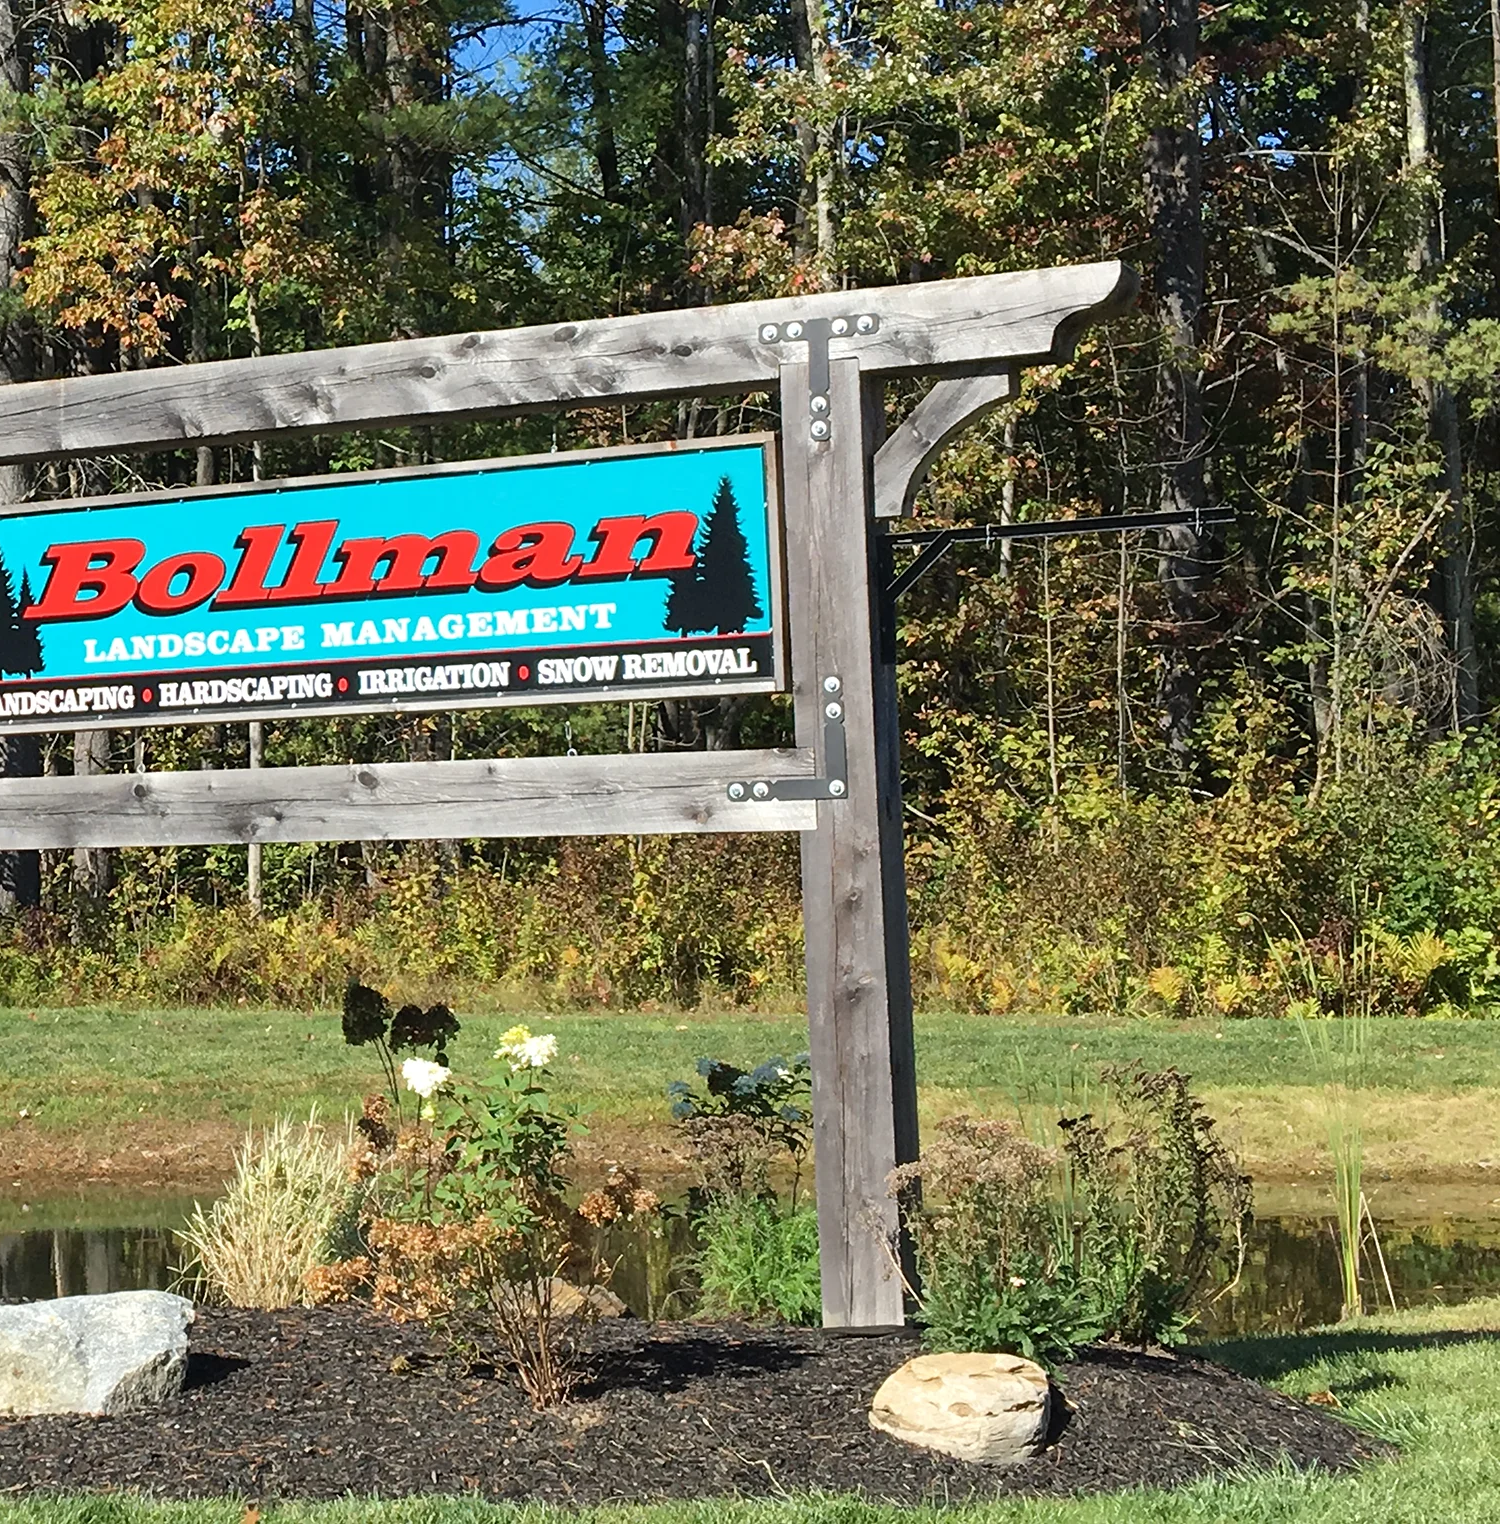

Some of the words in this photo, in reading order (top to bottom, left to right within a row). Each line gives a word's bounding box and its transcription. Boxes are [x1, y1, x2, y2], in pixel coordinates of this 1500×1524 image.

[22, 509, 699, 625] Bollman
[84, 626, 304, 663] LANDSCAPE
[321, 602, 616, 647] MANAGEMENT
[158, 672, 332, 708] HARDSCAPING
[357, 661, 511, 696] IRRIGATION
[537, 655, 618, 685] SNOW
[622, 647, 758, 679] REMOVAL
